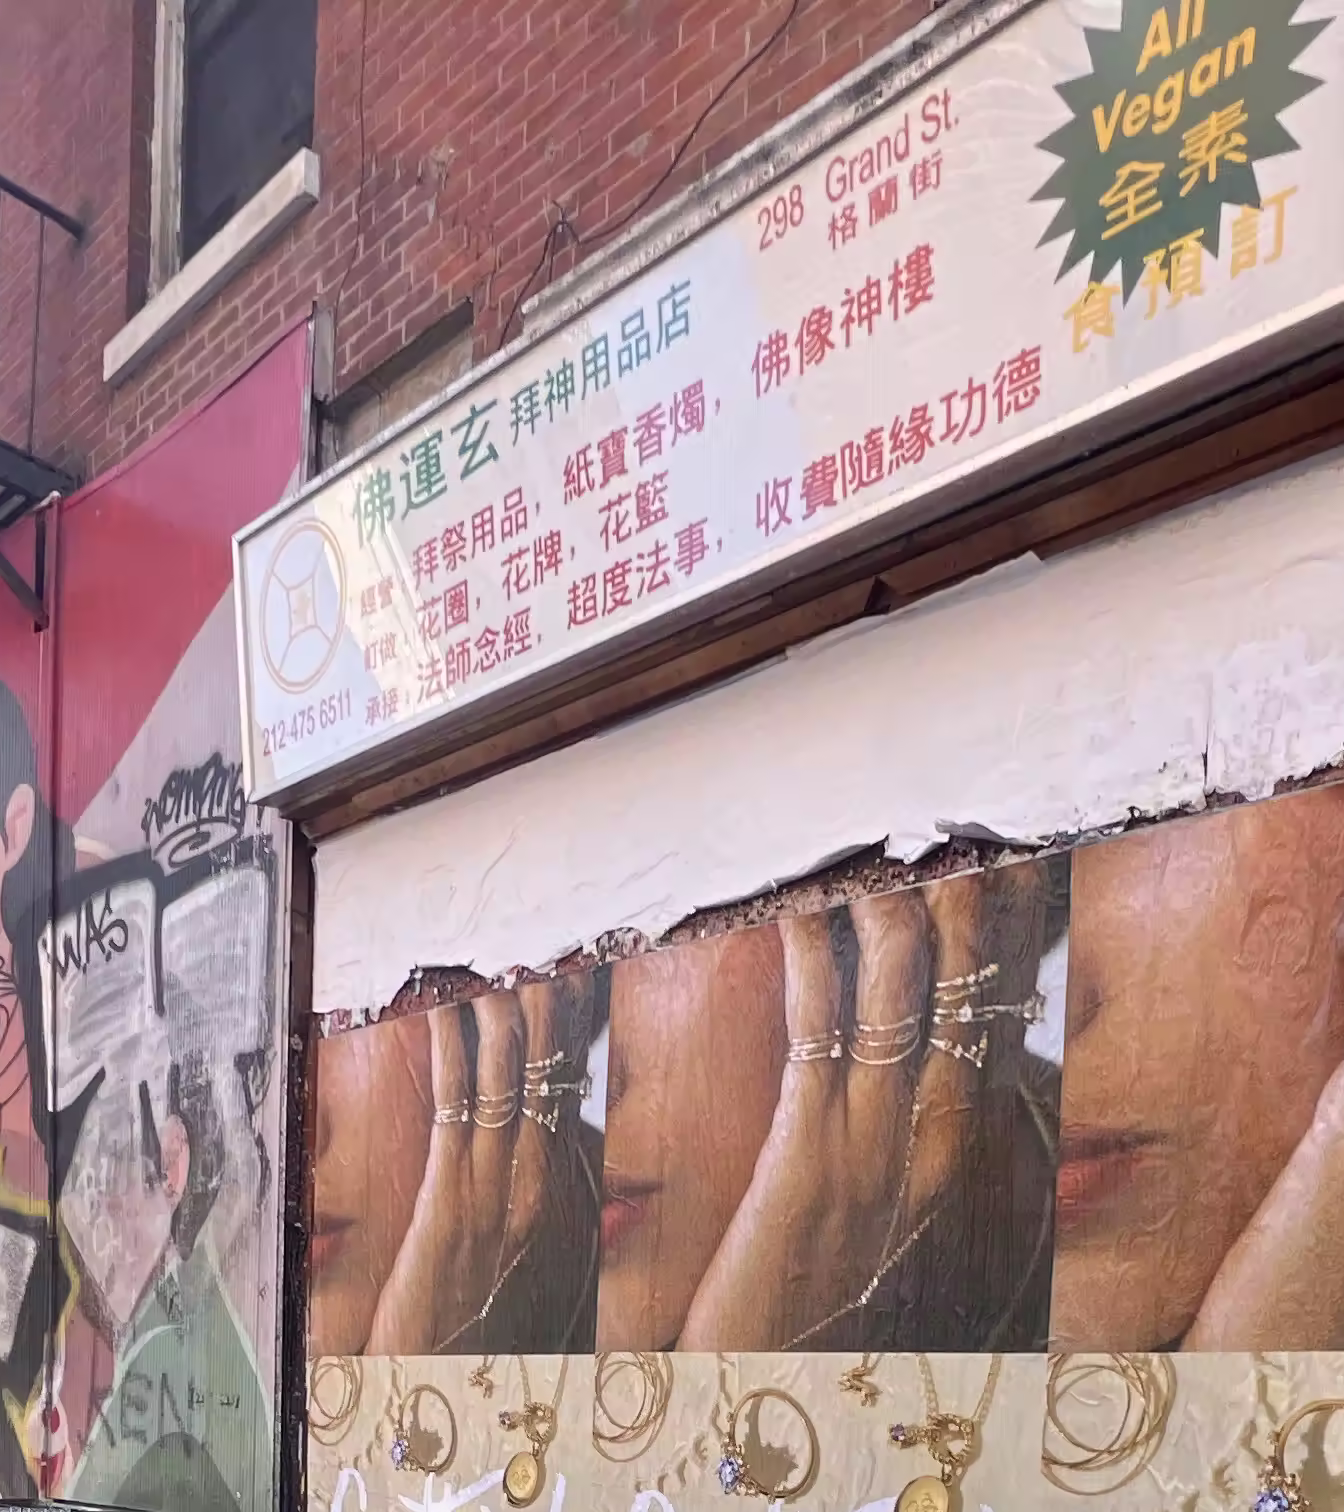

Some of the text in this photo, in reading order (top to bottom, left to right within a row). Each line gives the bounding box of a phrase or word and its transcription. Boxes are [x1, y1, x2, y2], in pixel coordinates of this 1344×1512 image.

[1092, 27, 1256, 153] Vegan
[1136, 0, 1205, 77] All
[757, 87, 959, 252] 298 Grand St.
[1099, 98, 1248, 240] 全素
[751, 244, 935, 399] 佛像神樓
[353, 279, 691, 549] 佛運玄 拜神用品店
[755, 344, 1042, 537] 收費隨緣功德
[598, 469, 669, 552] 花籃
[319, 687, 351, 730] 6511
